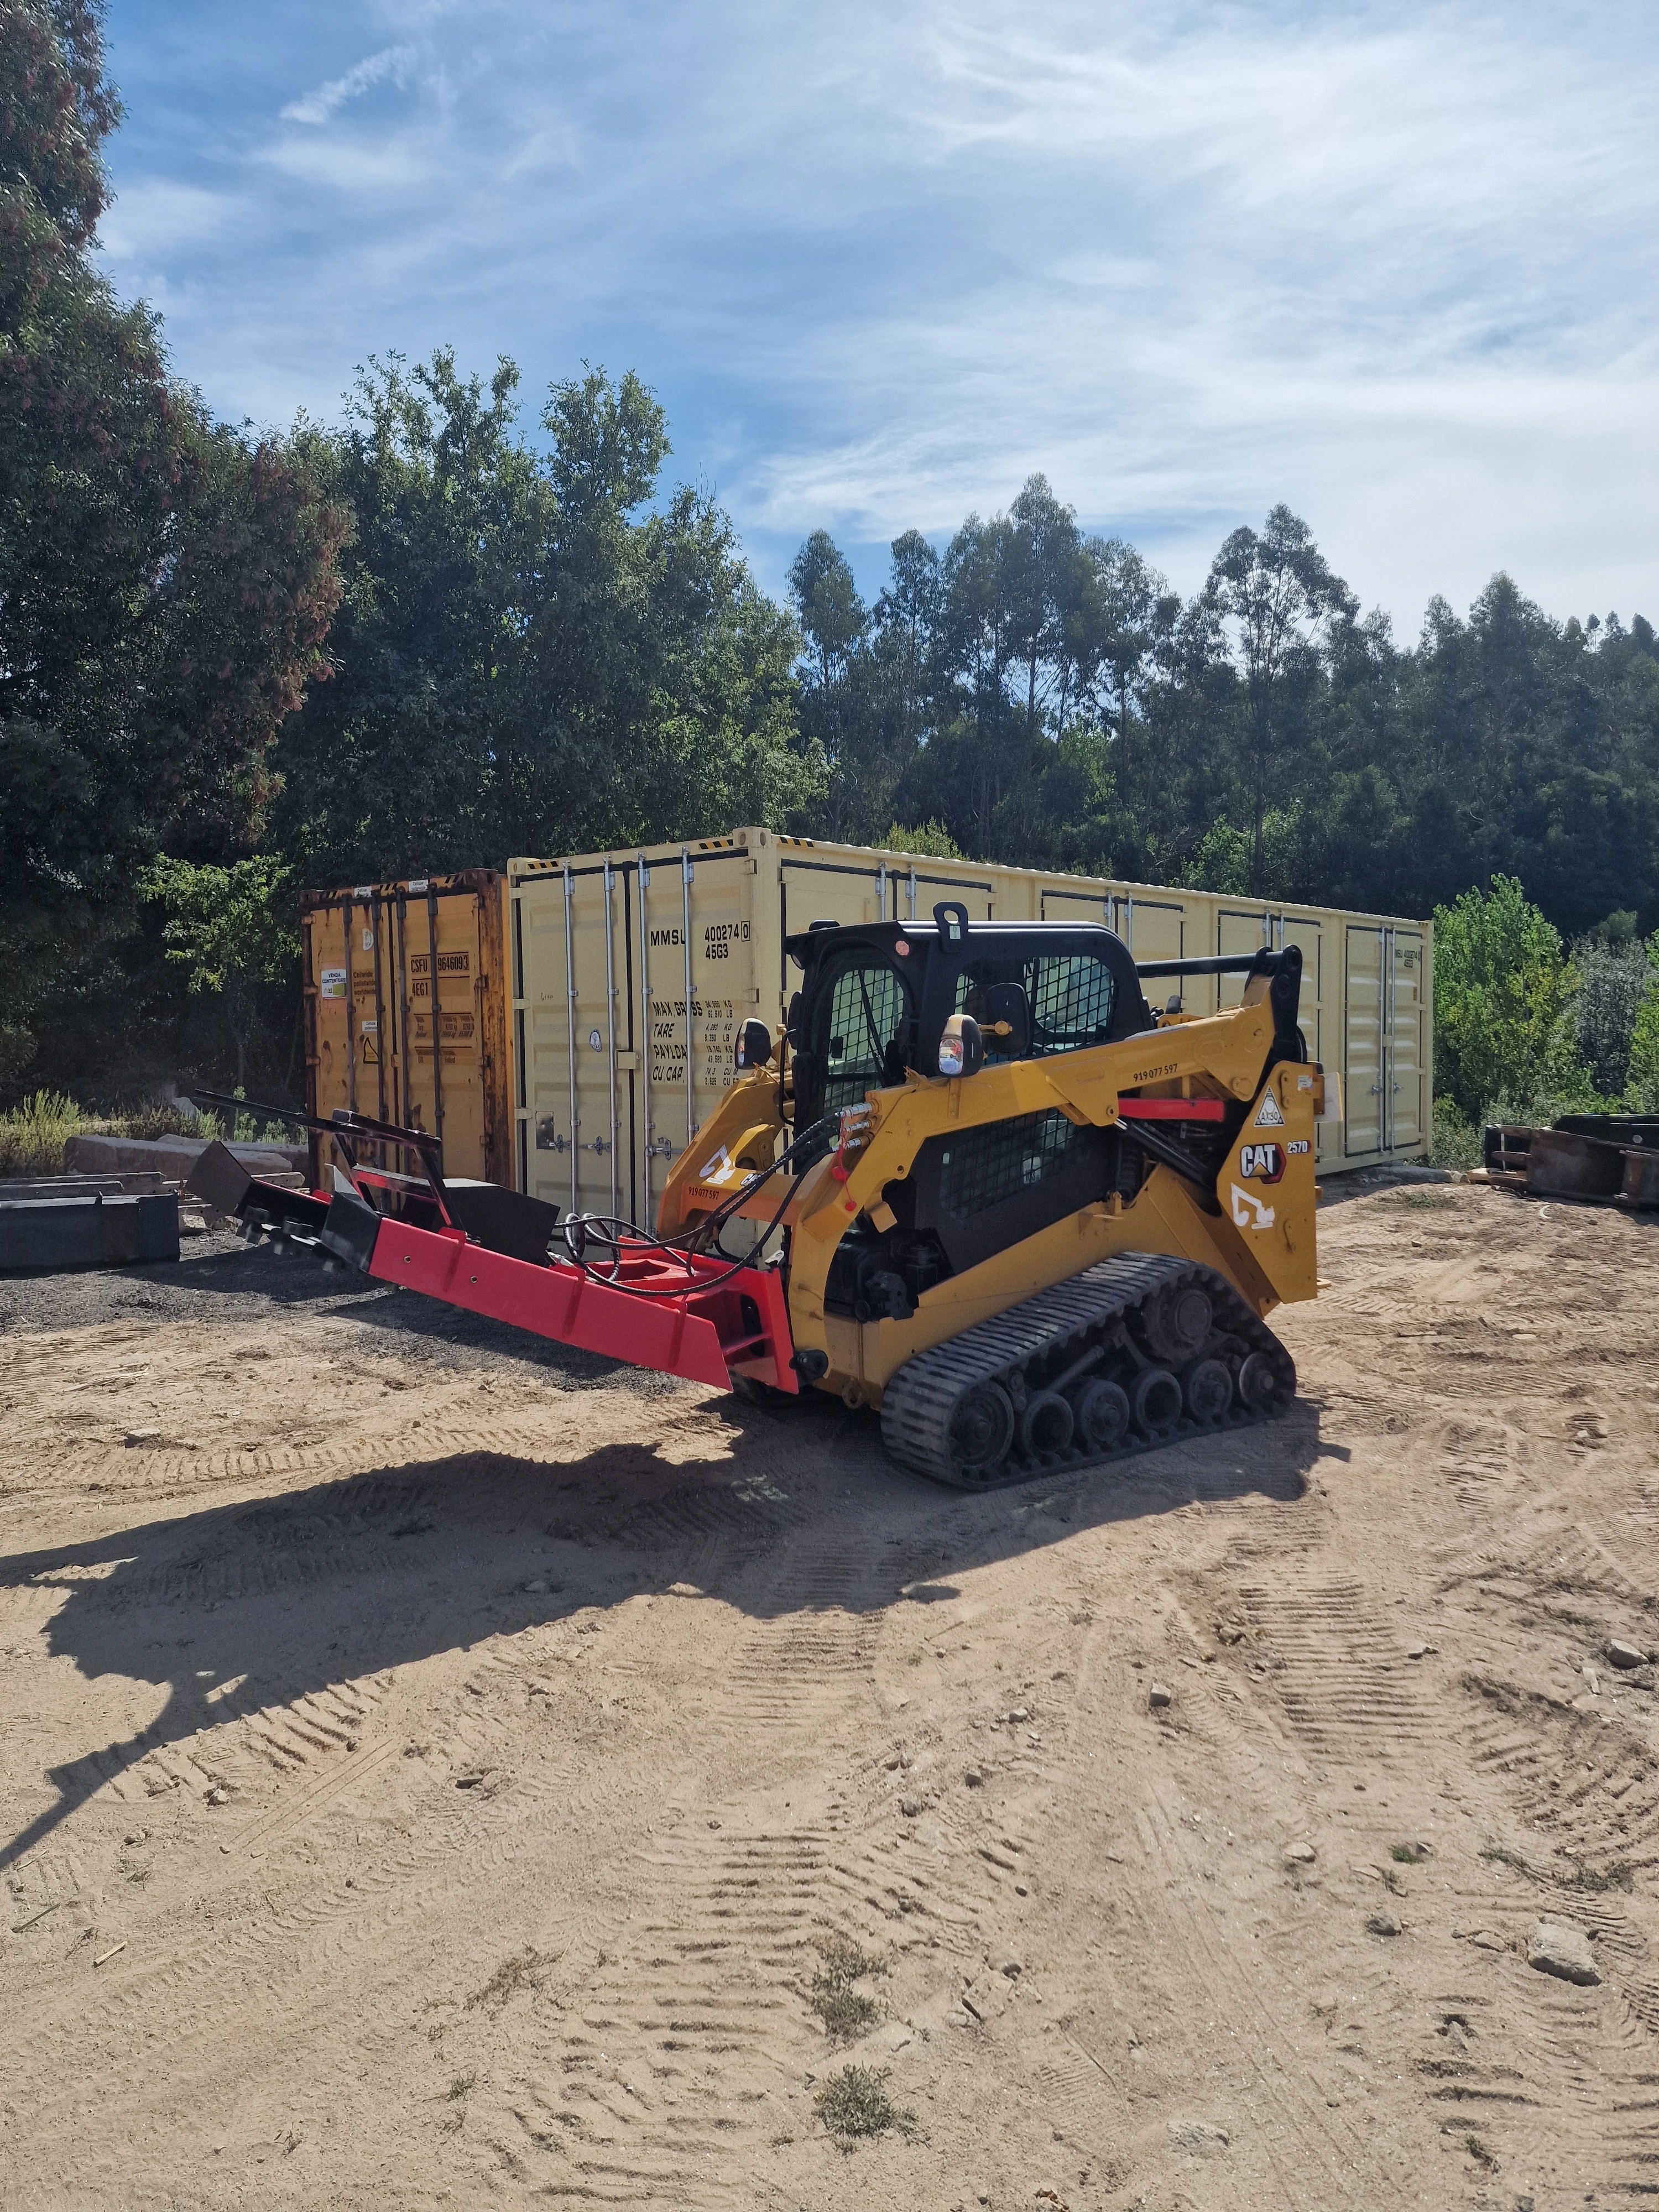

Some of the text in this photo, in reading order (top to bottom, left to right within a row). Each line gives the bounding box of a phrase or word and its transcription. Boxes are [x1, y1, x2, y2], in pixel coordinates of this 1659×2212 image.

[650, 929, 685, 946] MMSU
[706, 943, 728, 959] 45G3
[411, 958, 427, 972] CSFU
[411, 982, 428, 997] 4EG1
[652, 1001, 703, 1018] MAX.GRSS
[723, 1000, 732, 1008] KG
[726, 1009, 733, 1018] LB
[653, 1022, 675, 1038] TARE
[723, 1034, 730, 1042] LB
[653, 1044, 687, 1060] PAYLOA
[724, 1045, 733, 1053] KG
[726, 1055, 733, 1063] LB
[1287, 1140, 1308, 1154] 257D
[1241, 1144, 1276, 1177] CAT
[740, 1172, 760, 1186] CA
